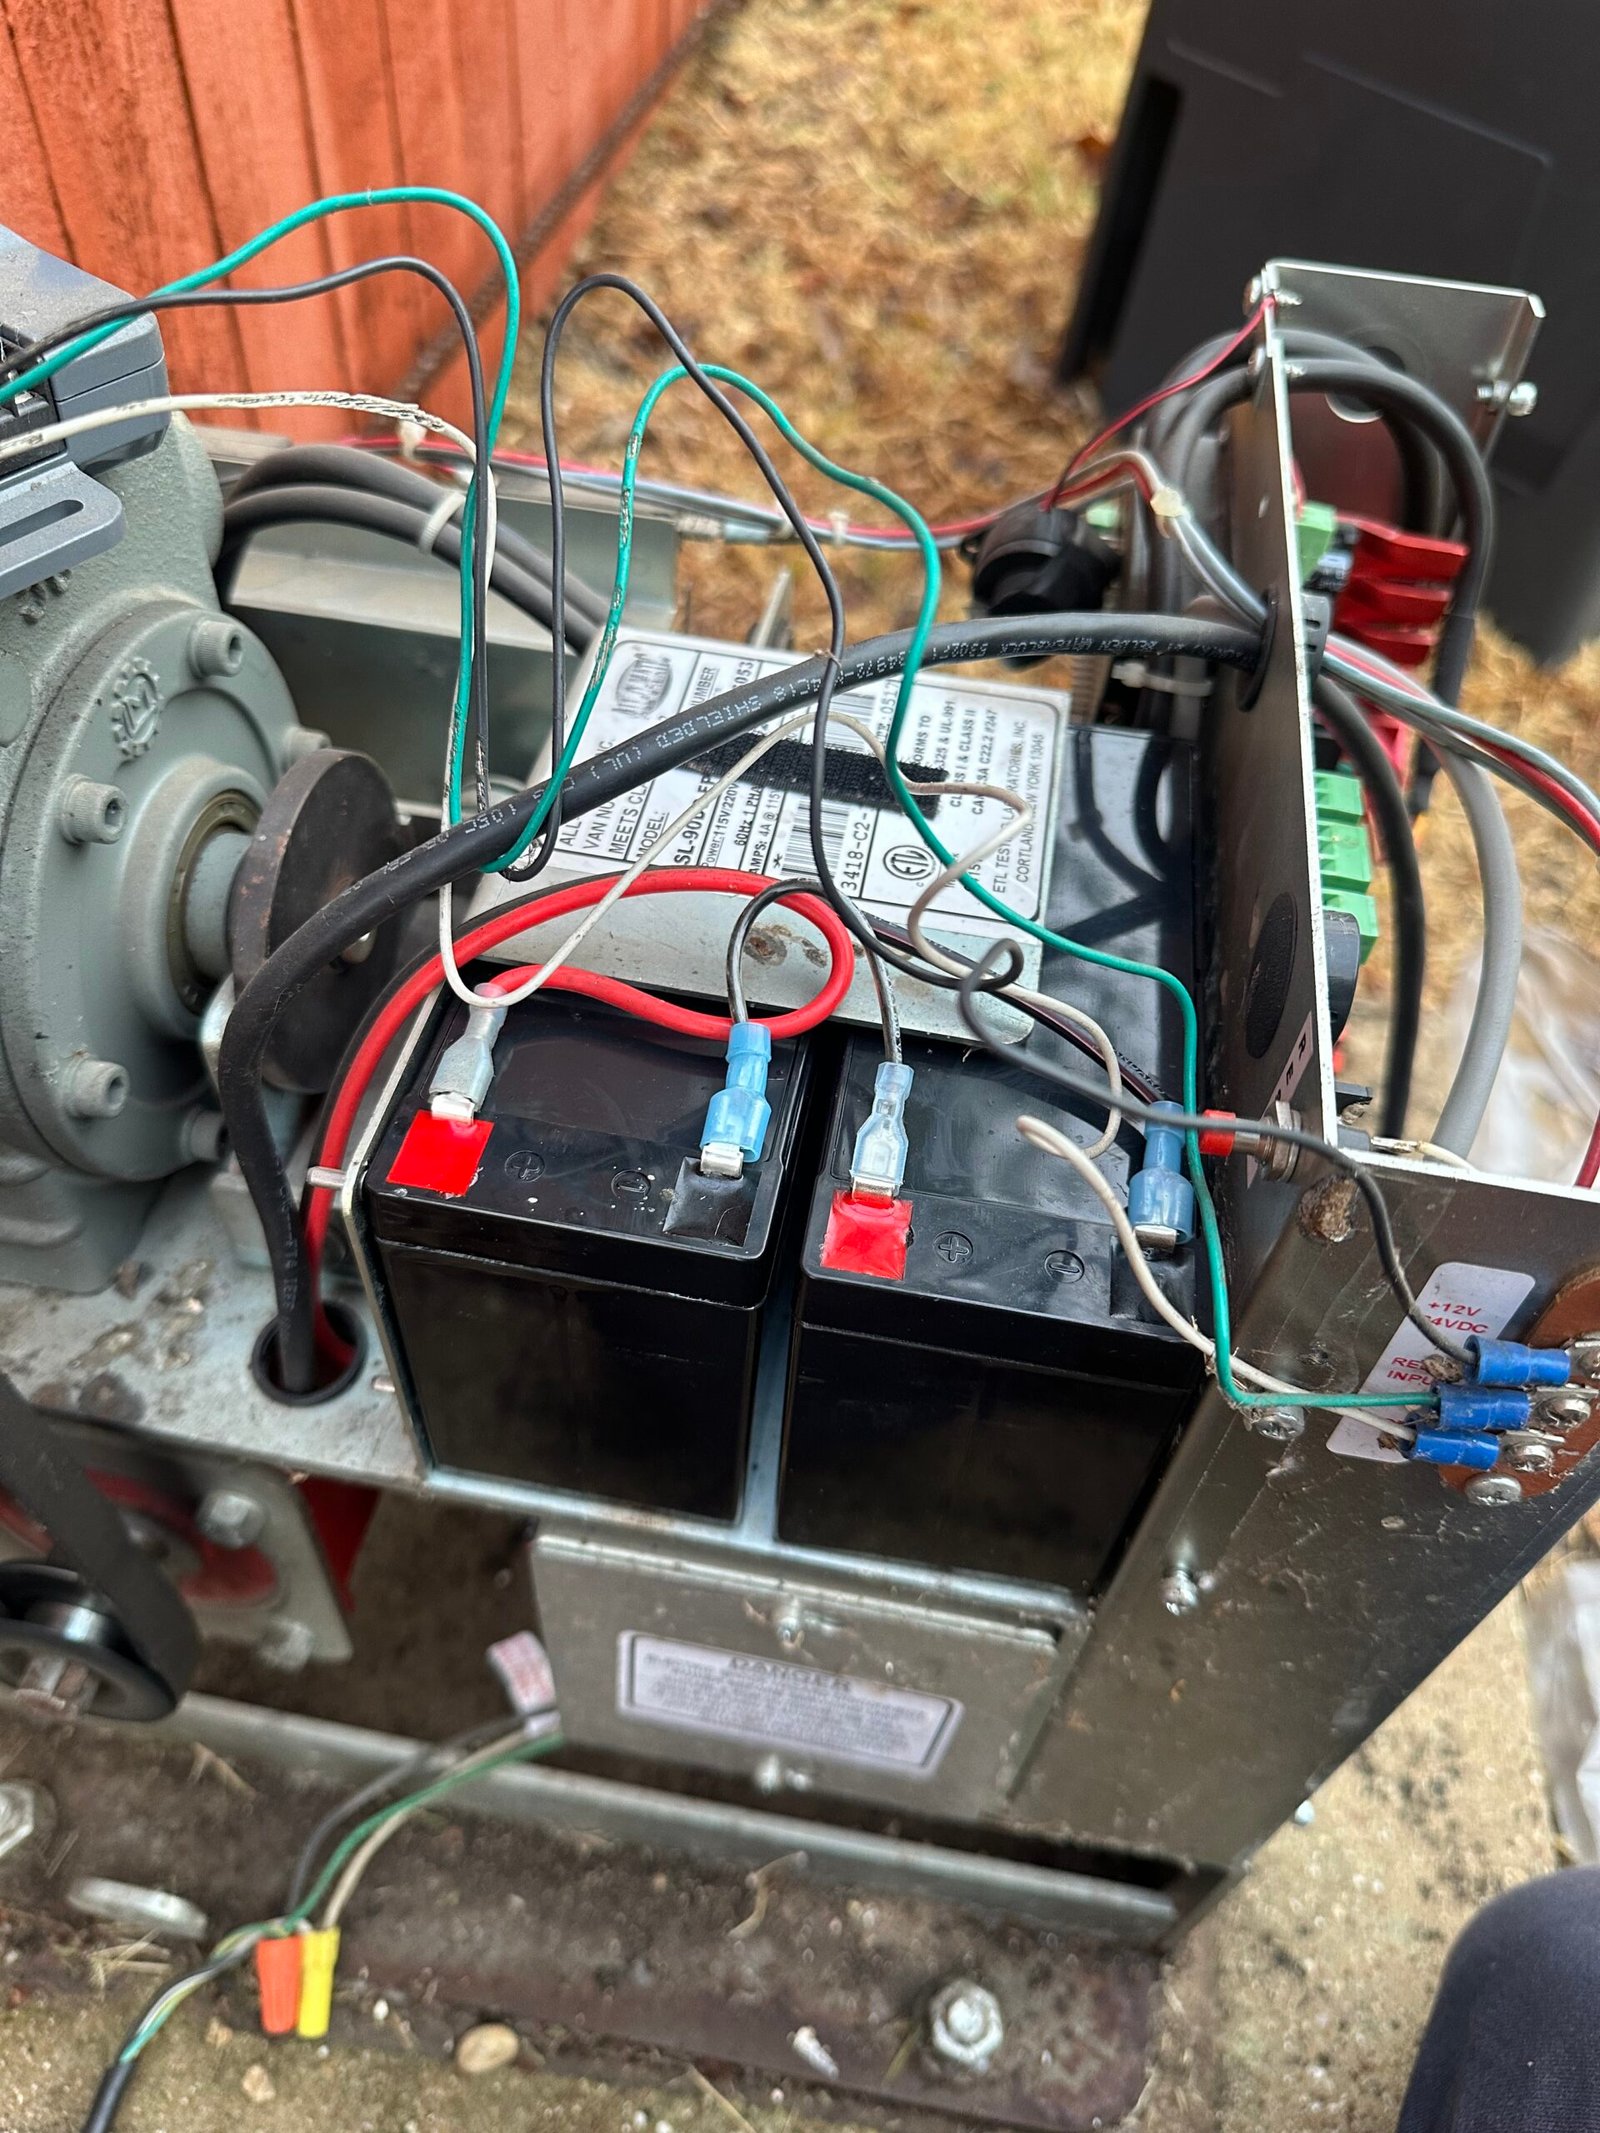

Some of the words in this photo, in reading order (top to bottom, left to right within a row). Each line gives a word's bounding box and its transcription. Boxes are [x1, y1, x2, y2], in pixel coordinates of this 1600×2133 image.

[655, 695, 762, 749] SHIELDED
[919, 715, 931, 731] TO
[913, 732, 928, 764] ORMS
[979, 735, 993, 764] C22.2
[590, 746, 642, 780] (UL)
[950, 772, 966, 807] CLSS
[959, 719, 975, 752] CLASS
[1026, 763, 1042, 793] YORK
[759, 824, 771, 837] 4A
[763, 811, 775, 821] @
[582, 821, 607, 849] VAN
[609, 808, 638, 854] MEETS
[636, 811, 666, 858] MODEL:
[734, 820, 752, 846] 60Hz
[749, 841, 768, 874] AMPS:
[993, 872, 1007, 893] ETL
[1427, 1301, 1482, 1317] +12V
